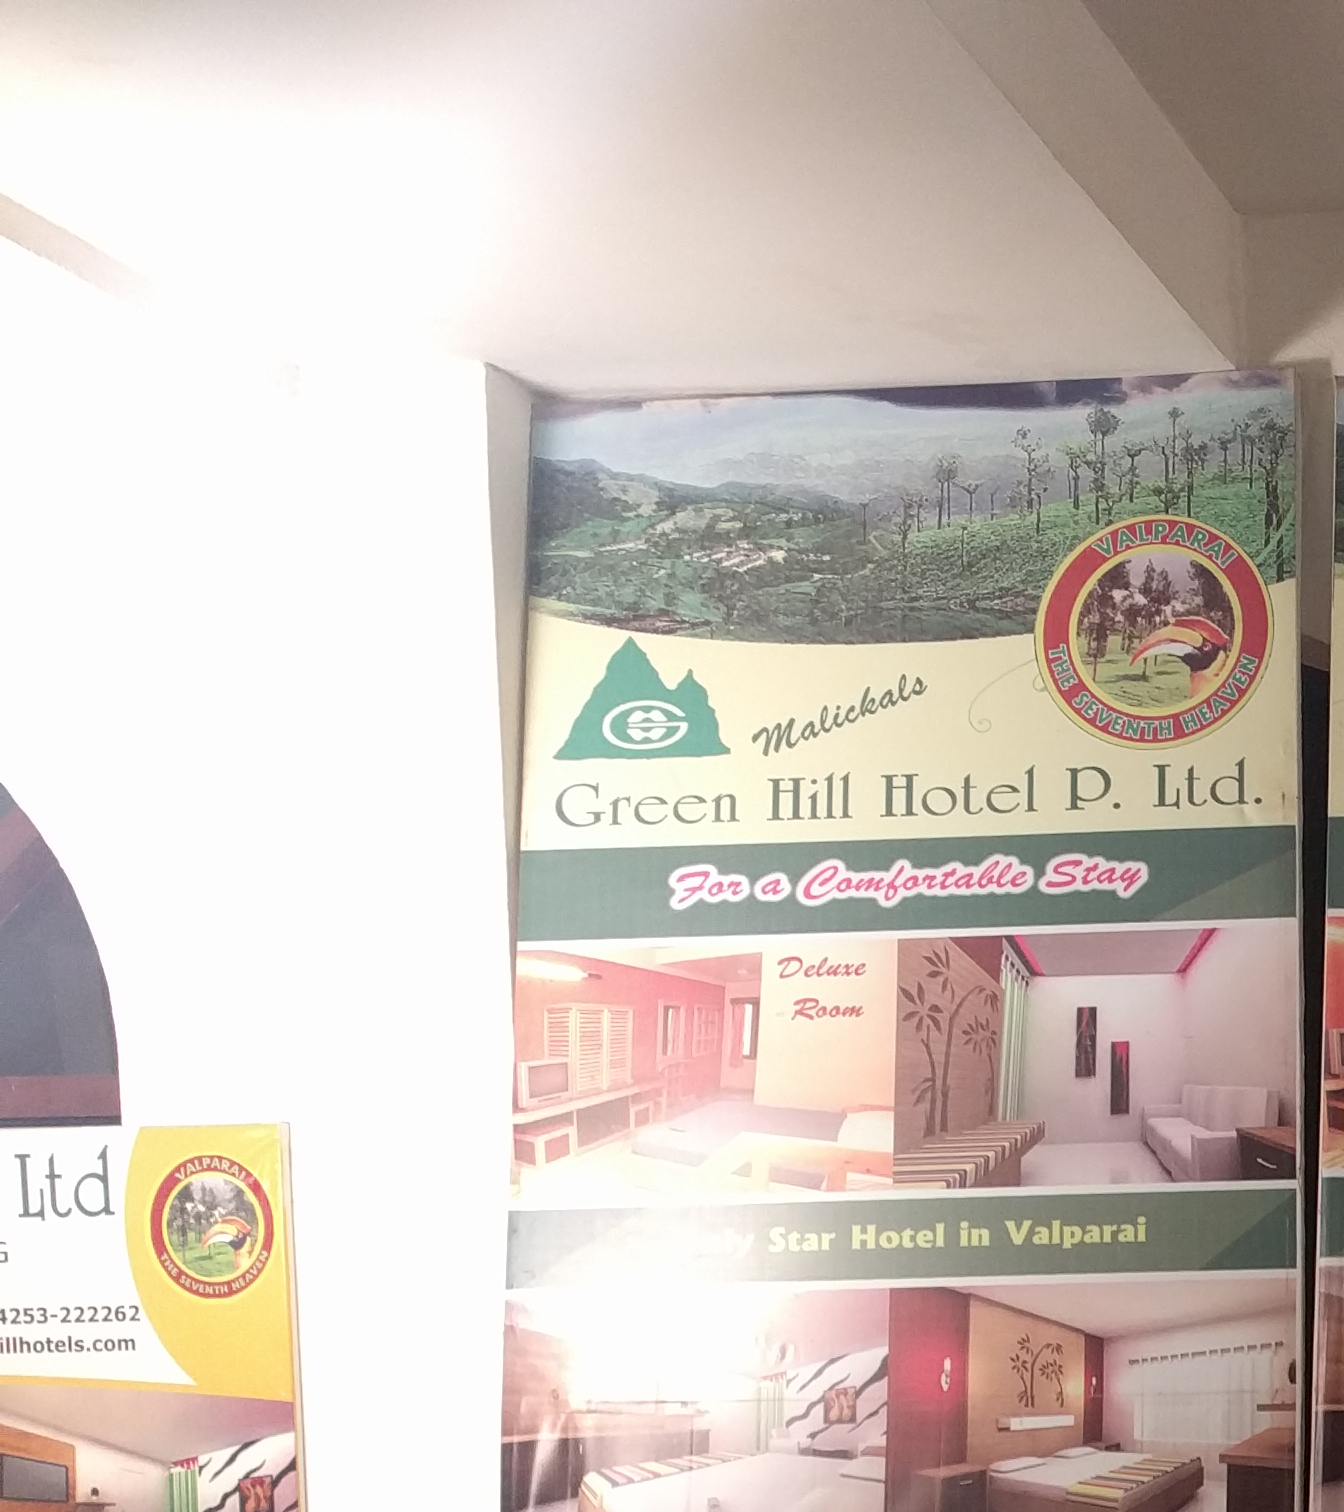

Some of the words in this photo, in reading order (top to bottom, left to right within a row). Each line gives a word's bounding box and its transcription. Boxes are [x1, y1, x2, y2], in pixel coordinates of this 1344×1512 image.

[1092, 521, 1238, 569] VALPARAI
[1048, 643, 1079, 691] THE
[1071, 691, 1174, 739] SEVENTH
[1181, 653, 1260, 733] HEAVEN
[751, 672, 929, 759] Malickals
[554, 781, 741, 829] Green
[766, 771, 854, 822] Hill
[880, 764, 1038, 819] Hotel
[1064, 766, 1122, 813] P.
[1153, 757, 1264, 811] Ltd.
[673, 868, 745, 906] For
[759, 878, 785, 898] a
[801, 859, 1031, 905] Comfortable
[1042, 856, 1146, 896] Stay
[777, 956, 867, 981] Deluxe
[791, 997, 865, 1024] Room
[14, 1144, 116, 1221] Ltd
[768, 1225, 836, 1252] Star
[851, 1223, 946, 1250] Hotel
[959, 1220, 990, 1247] in
[1004, 1217, 1148, 1250] Valparai
[159, 1251, 178, 1278] THE
[179, 1273, 230, 1295] SEVENTH
[231, 1249, 269, 1292] HEAVEN
[0, 1305, 140, 1325] 4253-222262
[0, 1335, 136, 1354] illhotels.com
